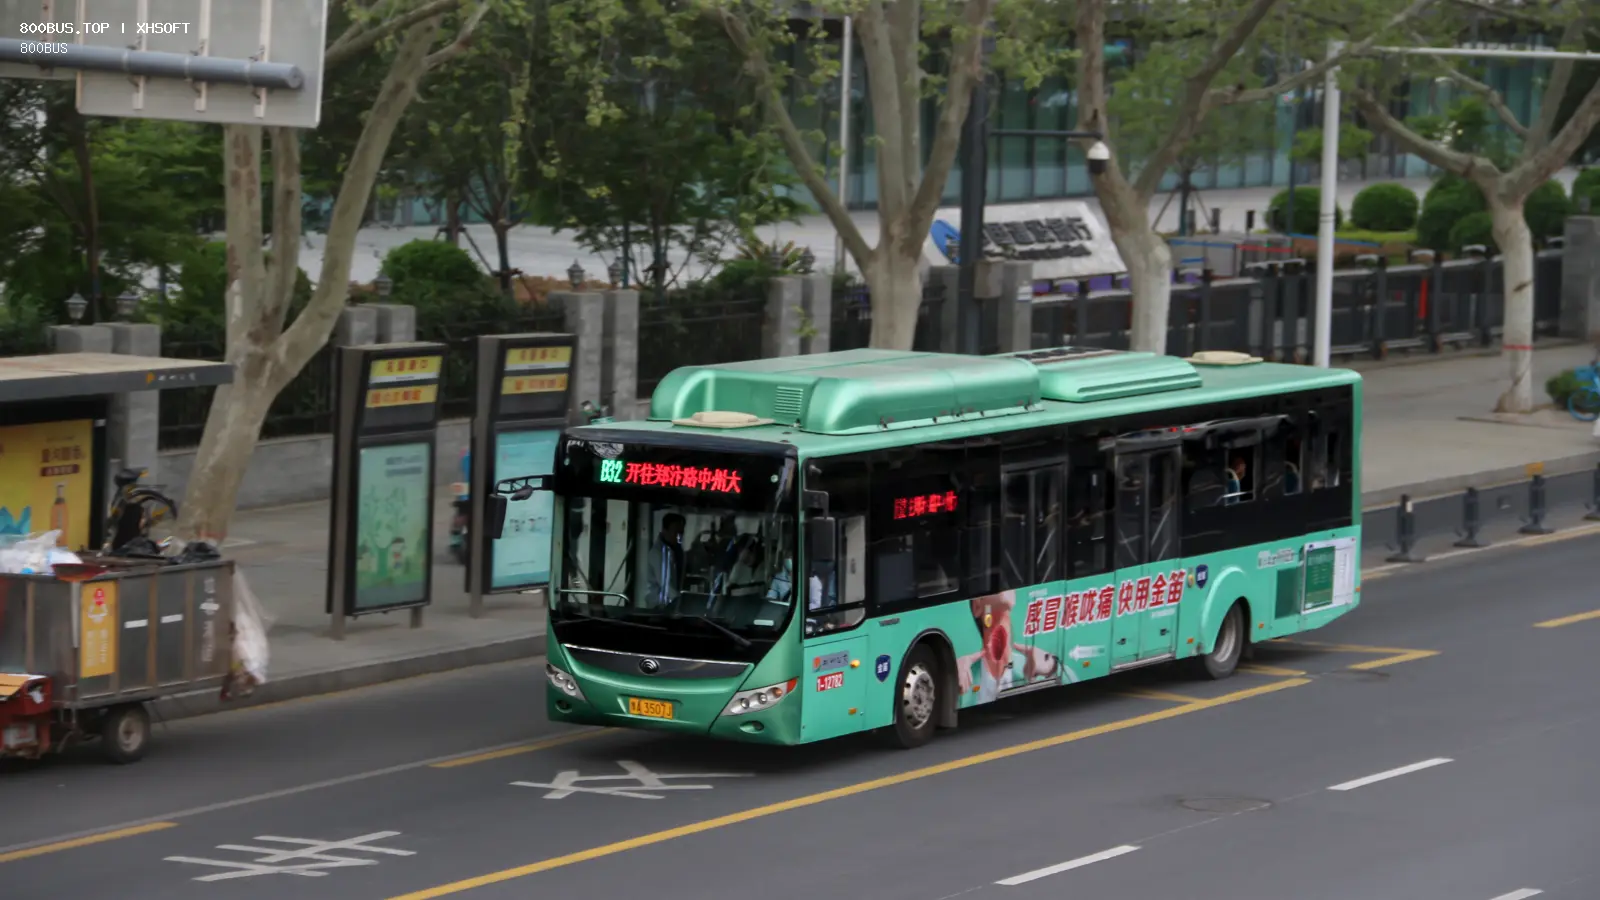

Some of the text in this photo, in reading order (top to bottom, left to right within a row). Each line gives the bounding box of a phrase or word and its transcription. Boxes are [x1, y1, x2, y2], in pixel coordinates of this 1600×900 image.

[600, 459, 623, 483] B32
[1024, 569, 1188, 638] 感冒喉咙痛 快用金笛
